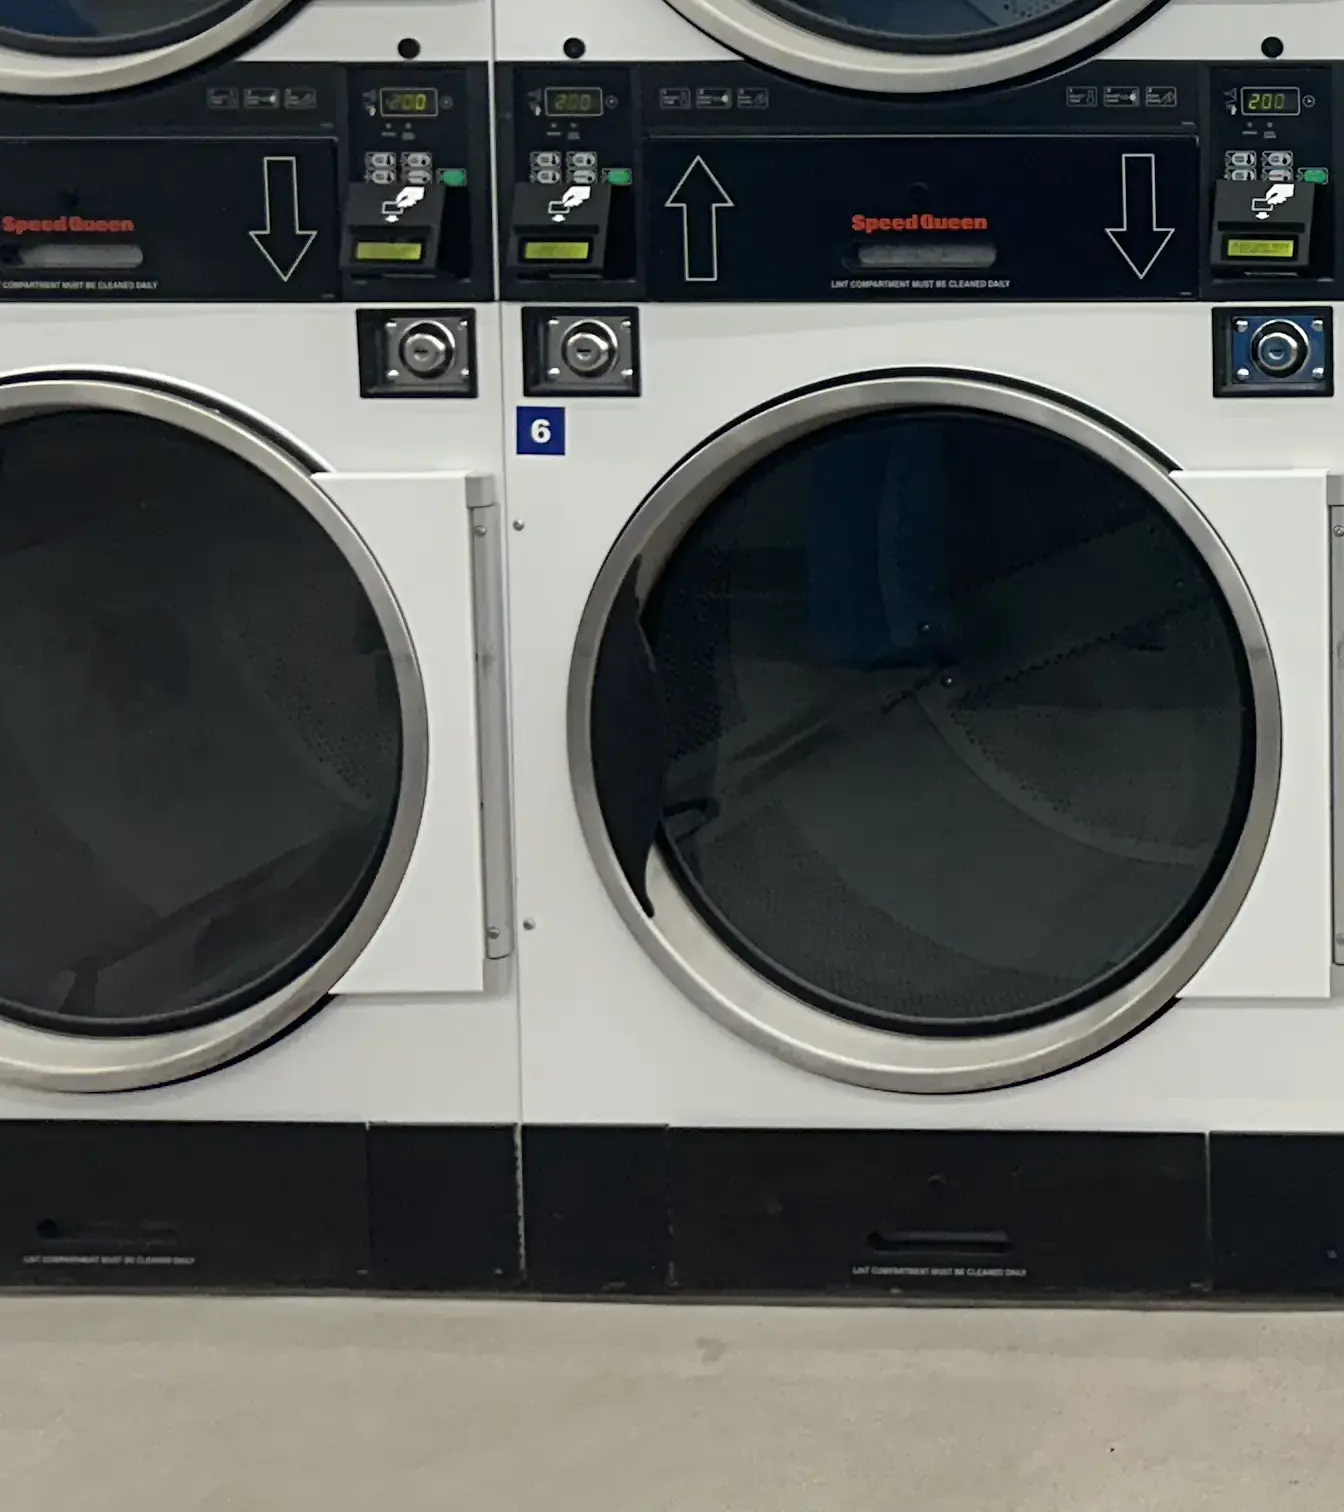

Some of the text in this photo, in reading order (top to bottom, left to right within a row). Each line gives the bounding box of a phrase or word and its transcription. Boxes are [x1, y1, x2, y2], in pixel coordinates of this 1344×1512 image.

[1248, 93, 1285, 110] 200
[3, 216, 135, 235] Speed Queen
[852, 214, 988, 233] Speed Queen
[531, 419, 551, 443] 6
